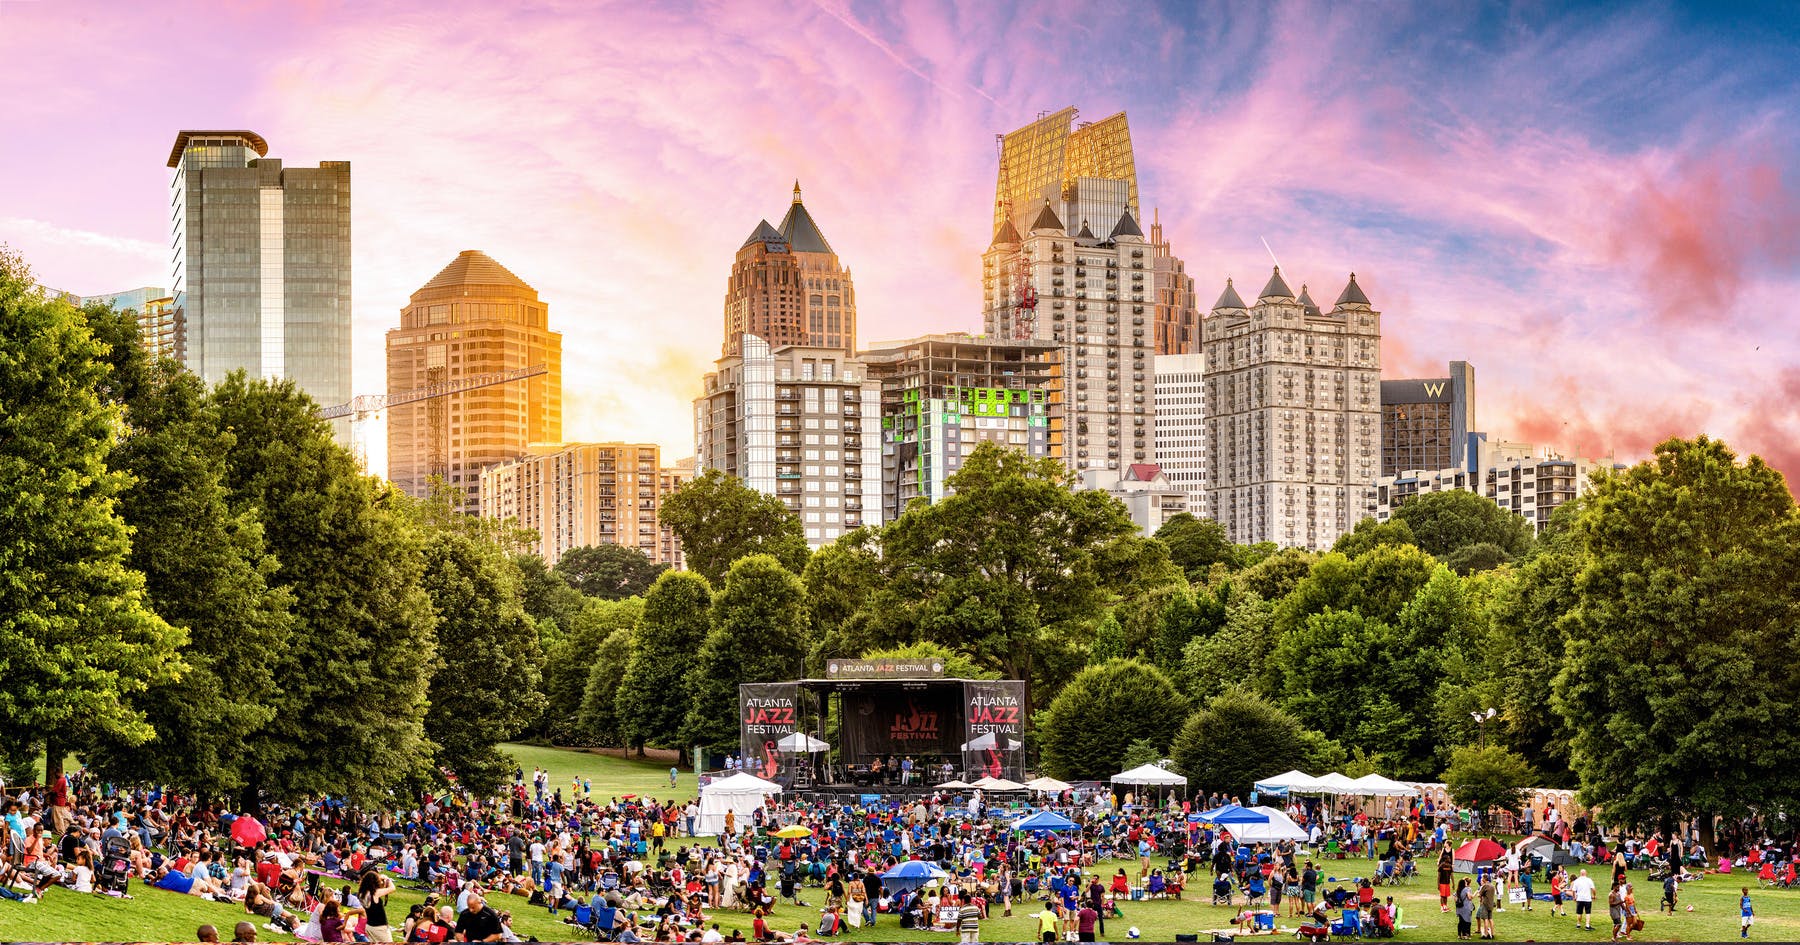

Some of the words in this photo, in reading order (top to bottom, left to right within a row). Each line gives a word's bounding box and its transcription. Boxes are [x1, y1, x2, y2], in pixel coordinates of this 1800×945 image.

[1423, 382, 1445, 398] W
[842, 664, 875, 672] ATLANTA
[876, 664, 894, 673] JAZZ
[895, 664, 928, 672] FESTIVAL
[746, 698, 793, 708] ATLANTA
[970, 696, 1018, 706] ATLANTA
[744, 707, 795, 724] JAZZ
[968, 706, 1019, 723] JAZZ
[747, 724, 794, 734] FESTIVAL
[971, 724, 1018, 734] FESTIVAL
